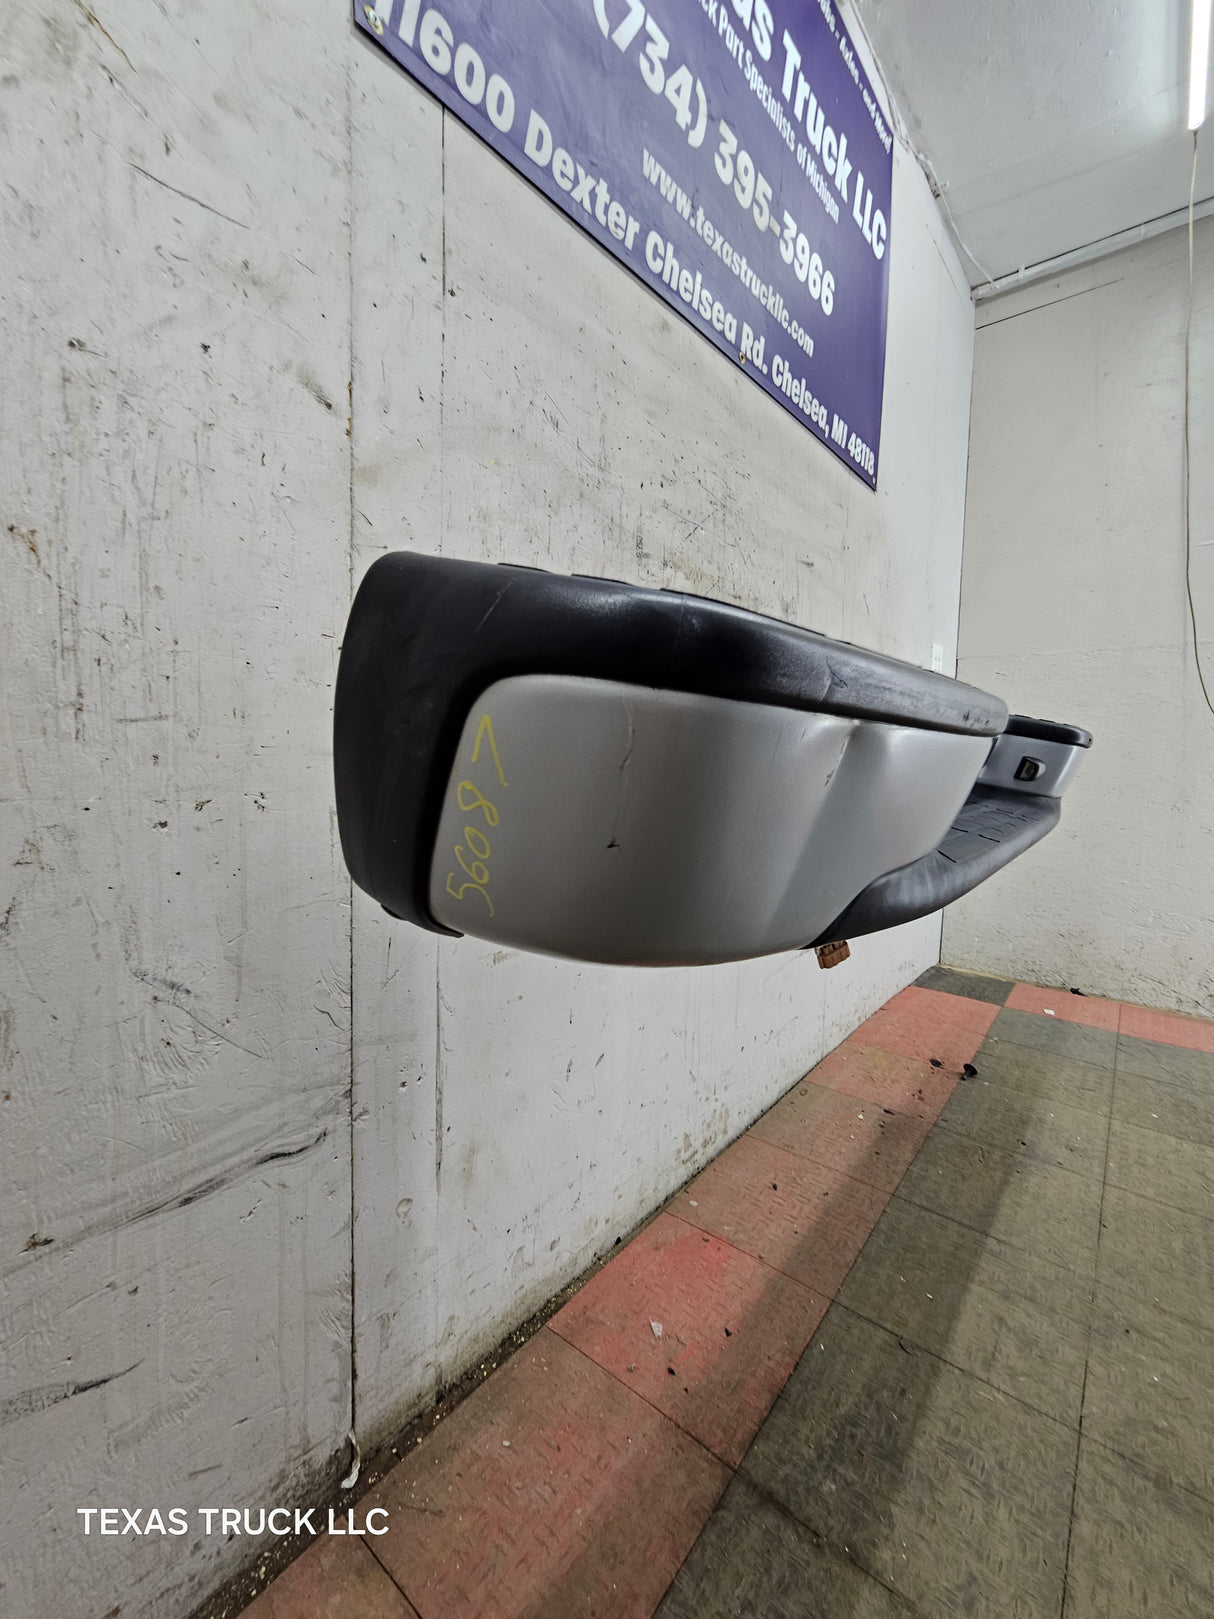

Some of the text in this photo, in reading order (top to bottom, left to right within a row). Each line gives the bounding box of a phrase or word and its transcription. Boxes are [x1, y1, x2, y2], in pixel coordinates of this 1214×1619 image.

[714, 119, 835, 316] 395-3966
[718, 4, 745, 70] Part
[744, 49, 796, 152] Specialists
[796, 142, 807, 171] of
[805, 153, 840, 225] Michigan
[782, 28, 852, 203] Truck
[852, 171, 887, 260] LLC
[524, 108, 640, 251] Dexter
[645, 230, 738, 344] Chelsea
[740, 321, 769, 375] Rd.
[771, 354, 830, 438] Chelsea,
[831, 413, 848, 449] MI
[847, 431, 875, 476] 48118
[642, 148, 815, 357] www.texastruckllc.com
